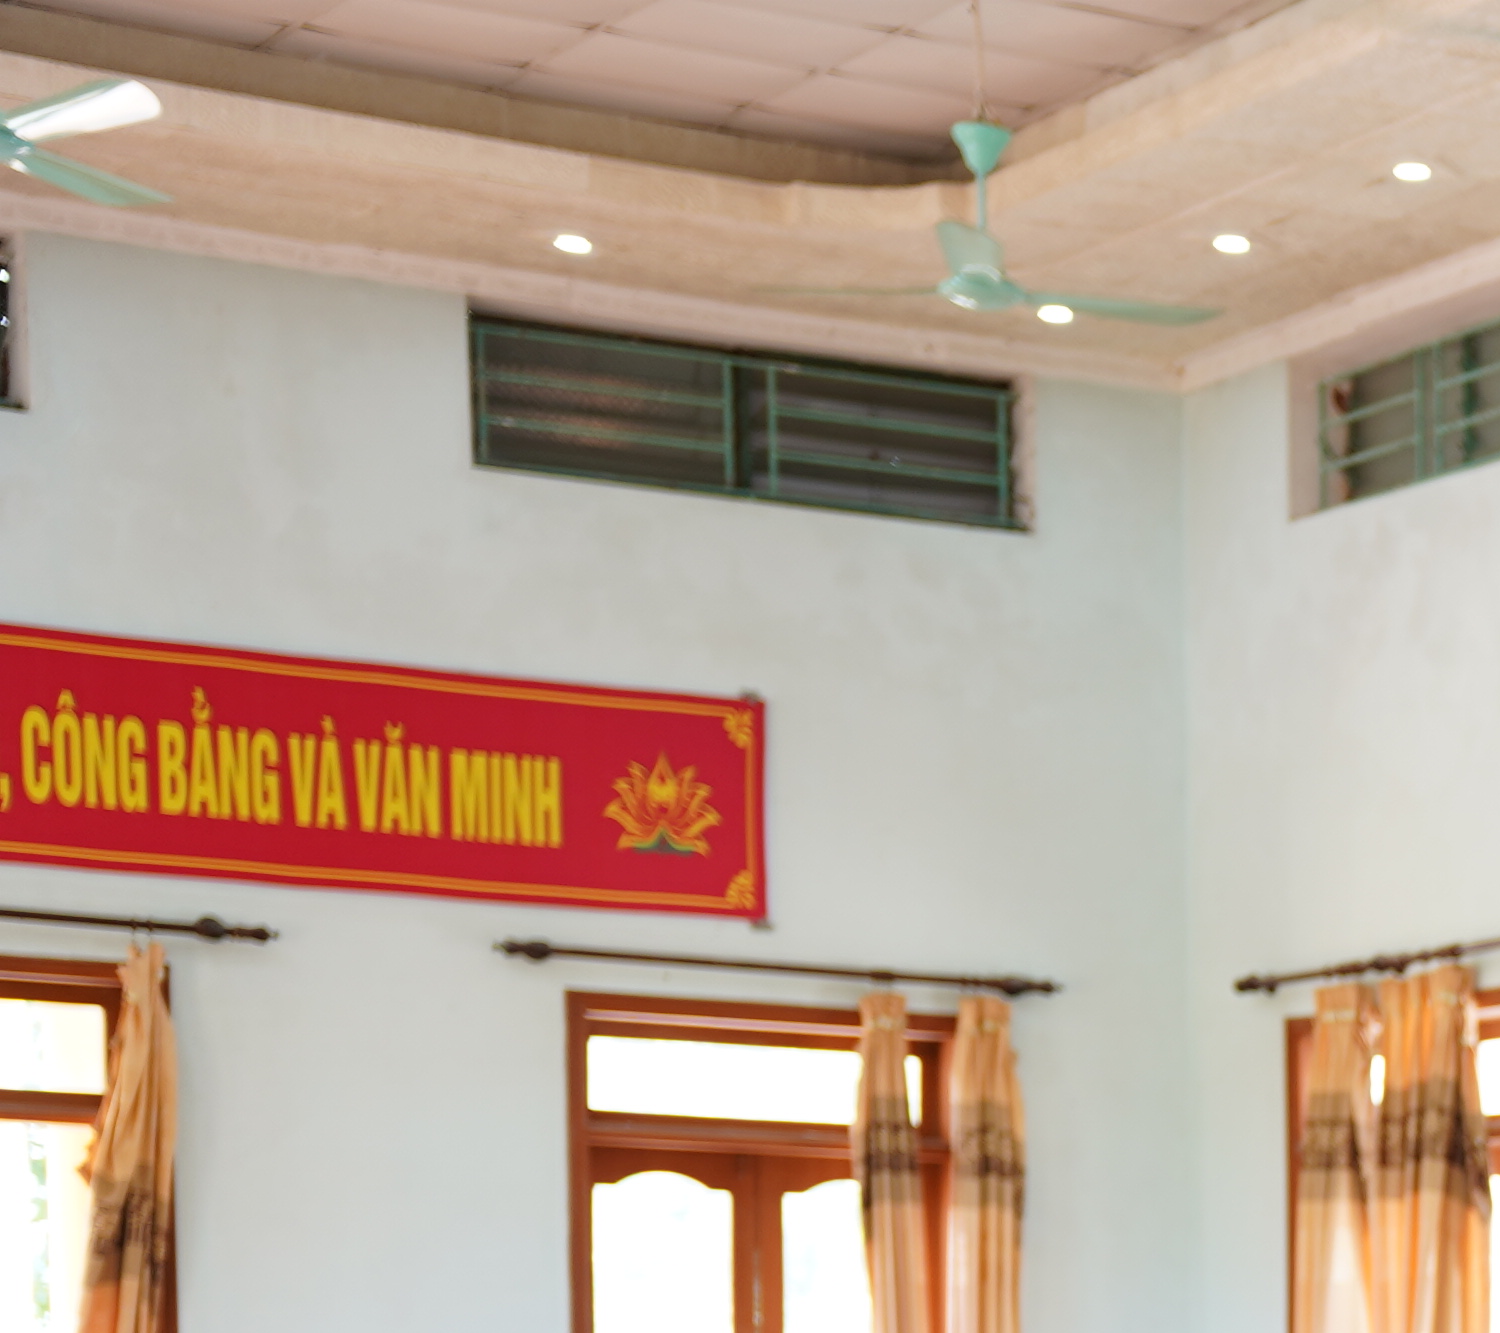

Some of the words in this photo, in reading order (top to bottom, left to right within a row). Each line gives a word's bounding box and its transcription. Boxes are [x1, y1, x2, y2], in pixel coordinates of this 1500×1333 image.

[20, 688, 150, 815] CÔNG
[157, 685, 282, 825] BẰNG
[288, 714, 348, 829] VÀ
[353, 720, 443, 839] VĂN
[449, 747, 564, 848] MINH
